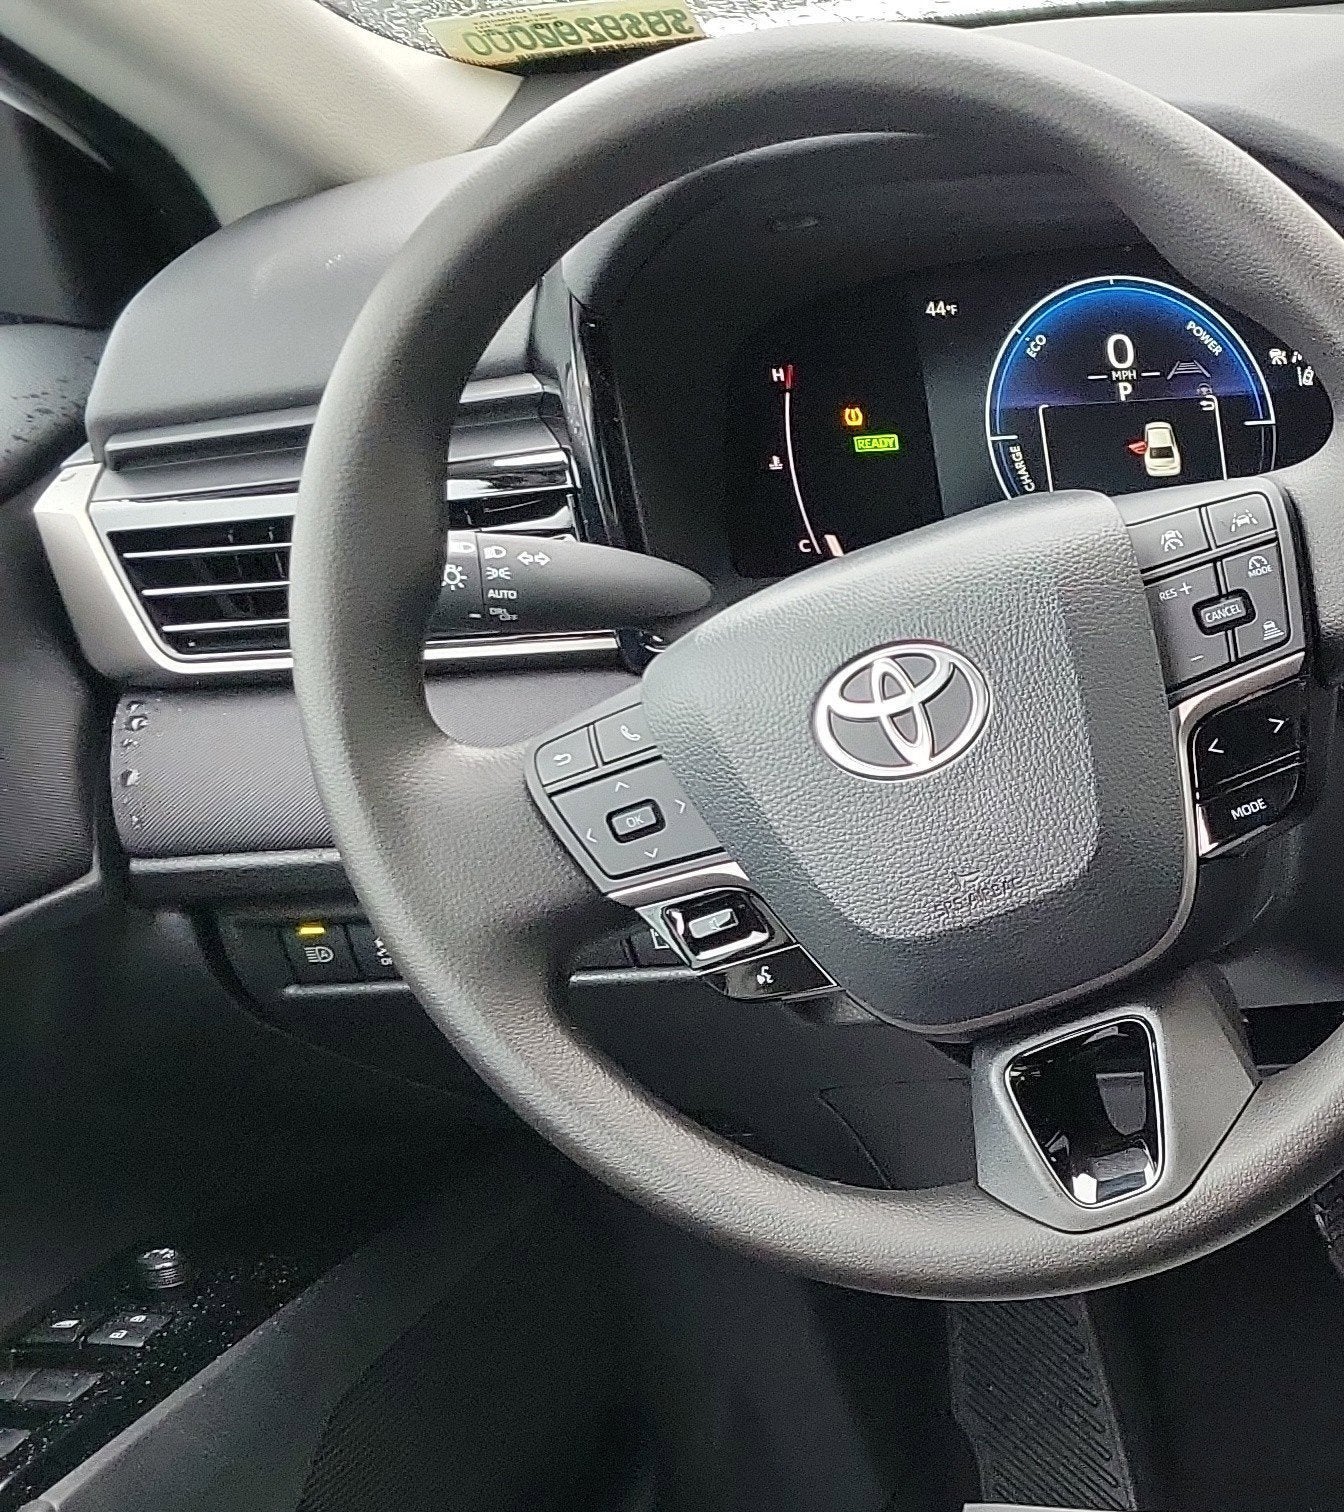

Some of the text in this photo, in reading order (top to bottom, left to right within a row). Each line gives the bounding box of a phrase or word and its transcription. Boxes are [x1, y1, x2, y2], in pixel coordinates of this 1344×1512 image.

[1186, 320, 1223, 357] POWER
[1026, 334, 1047, 358] ECO
[772, 368, 785, 382] H
[1111, 369, 1137, 381] MPH
[1118, 382, 1133, 402] P
[857, 437, 896, 450] READY
[1014, 445, 1036, 493] CHARGE
[798, 540, 811, 552] C
[1247, 564, 1273, 577] MODE
[487, 589, 517, 600] AUTO
[1159, 589, 1178, 602] RES
[1204, 604, 1242, 623] CANCEL
[1231, 798, 1267, 820] MODE
[626, 815, 645, 829] OK
